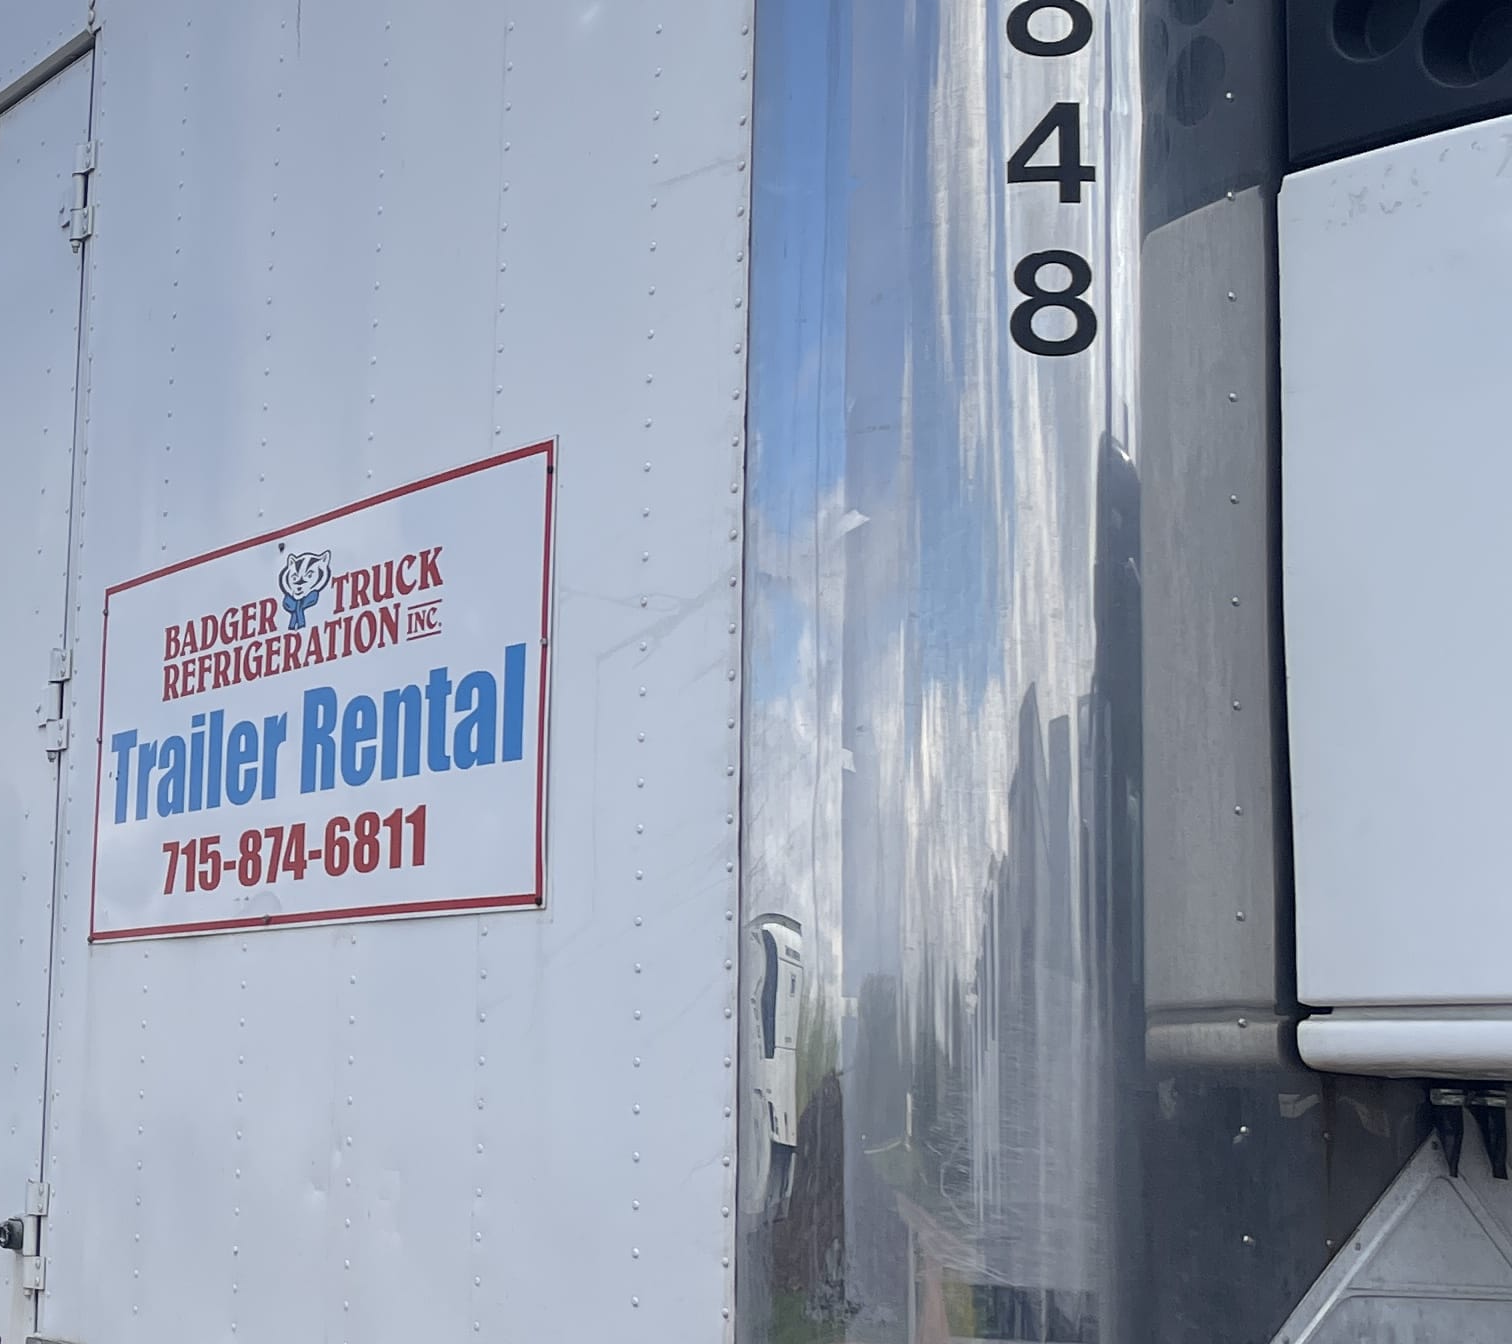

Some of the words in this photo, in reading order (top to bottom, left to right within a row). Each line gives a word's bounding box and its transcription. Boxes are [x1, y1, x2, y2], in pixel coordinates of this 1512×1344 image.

[162, 603, 402, 702] REFRIGERATION
[164, 597, 278, 661] BADGER
[331, 546, 444, 614] TRUCK
[111, 709, 288, 825] Trailer
[300, 643, 526, 794] Rental
[162, 804, 426, 895] 715-874-6811
